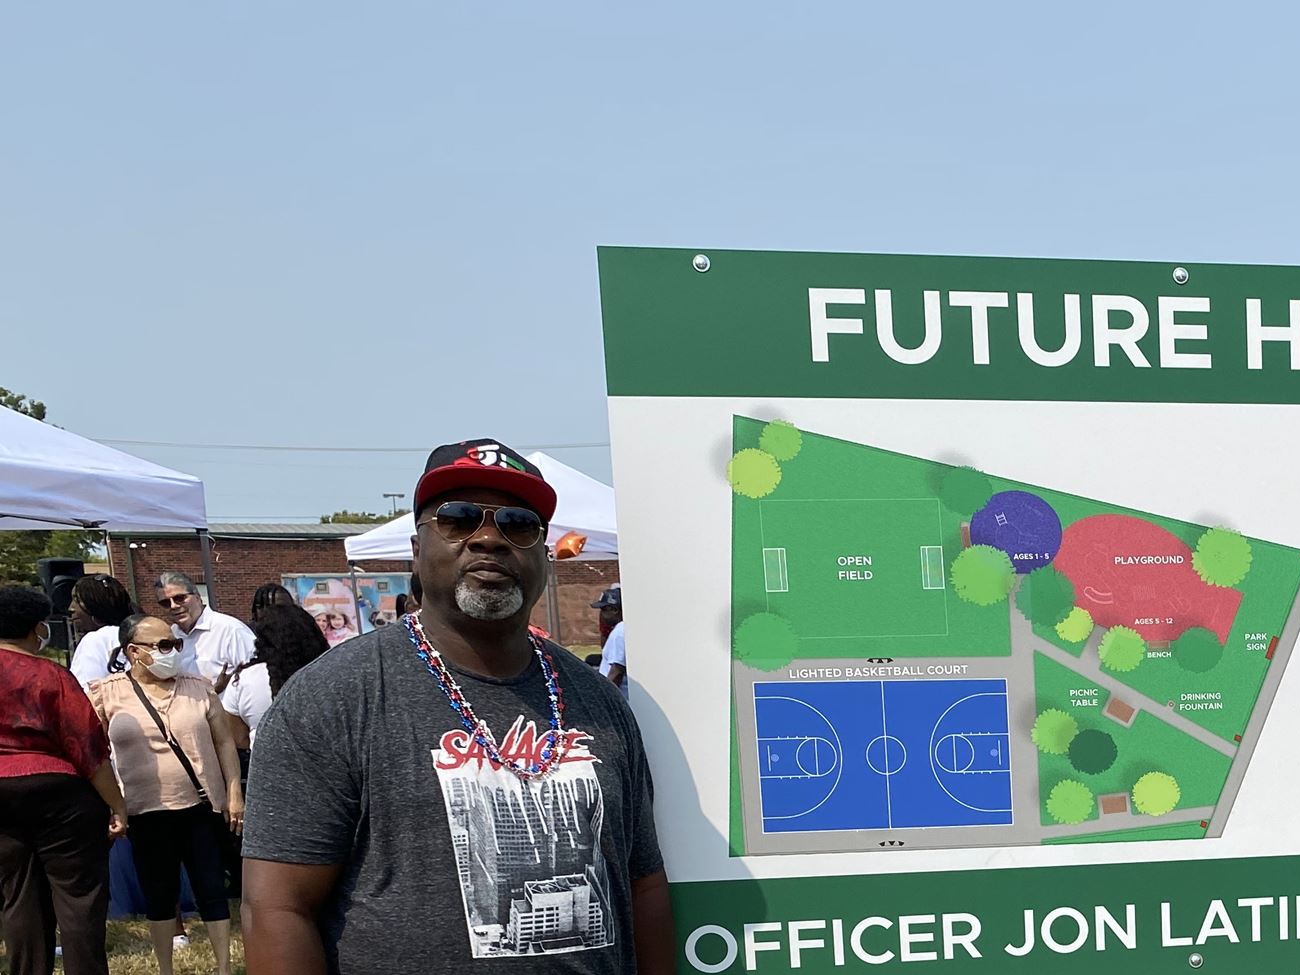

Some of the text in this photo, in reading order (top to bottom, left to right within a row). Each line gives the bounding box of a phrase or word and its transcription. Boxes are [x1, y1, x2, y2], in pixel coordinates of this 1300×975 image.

[808, 286, 1212, 369] FUTURE
[1013, 552, 1034, 560] AGES
[1044, 552, 1050, 560] 5
[1114, 555, 1184, 565] PLAYGROUND
[837, 556, 872, 566] OPEN
[838, 570, 873, 581] FIELD
[1154, 617, 1160, 625] 5
[1165, 617, 1174, 625] 12
[1244, 632, 1268, 641] PARK
[1246, 642, 1267, 651] SIGN
[1147, 651, 1172, 659] BENCH
[788, 664, 969, 679] LIGHTED BASKETBALL COURT
[1069, 688, 1099, 697] PICNIC
[1180, 692, 1222, 702] DRINKING
[1070, 698, 1099, 707] TABLE
[1179, 702, 1223, 711] FOUNTAIN
[684, 912, 983, 974] OFFICER
[1004, 904, 1137, 956] JON
